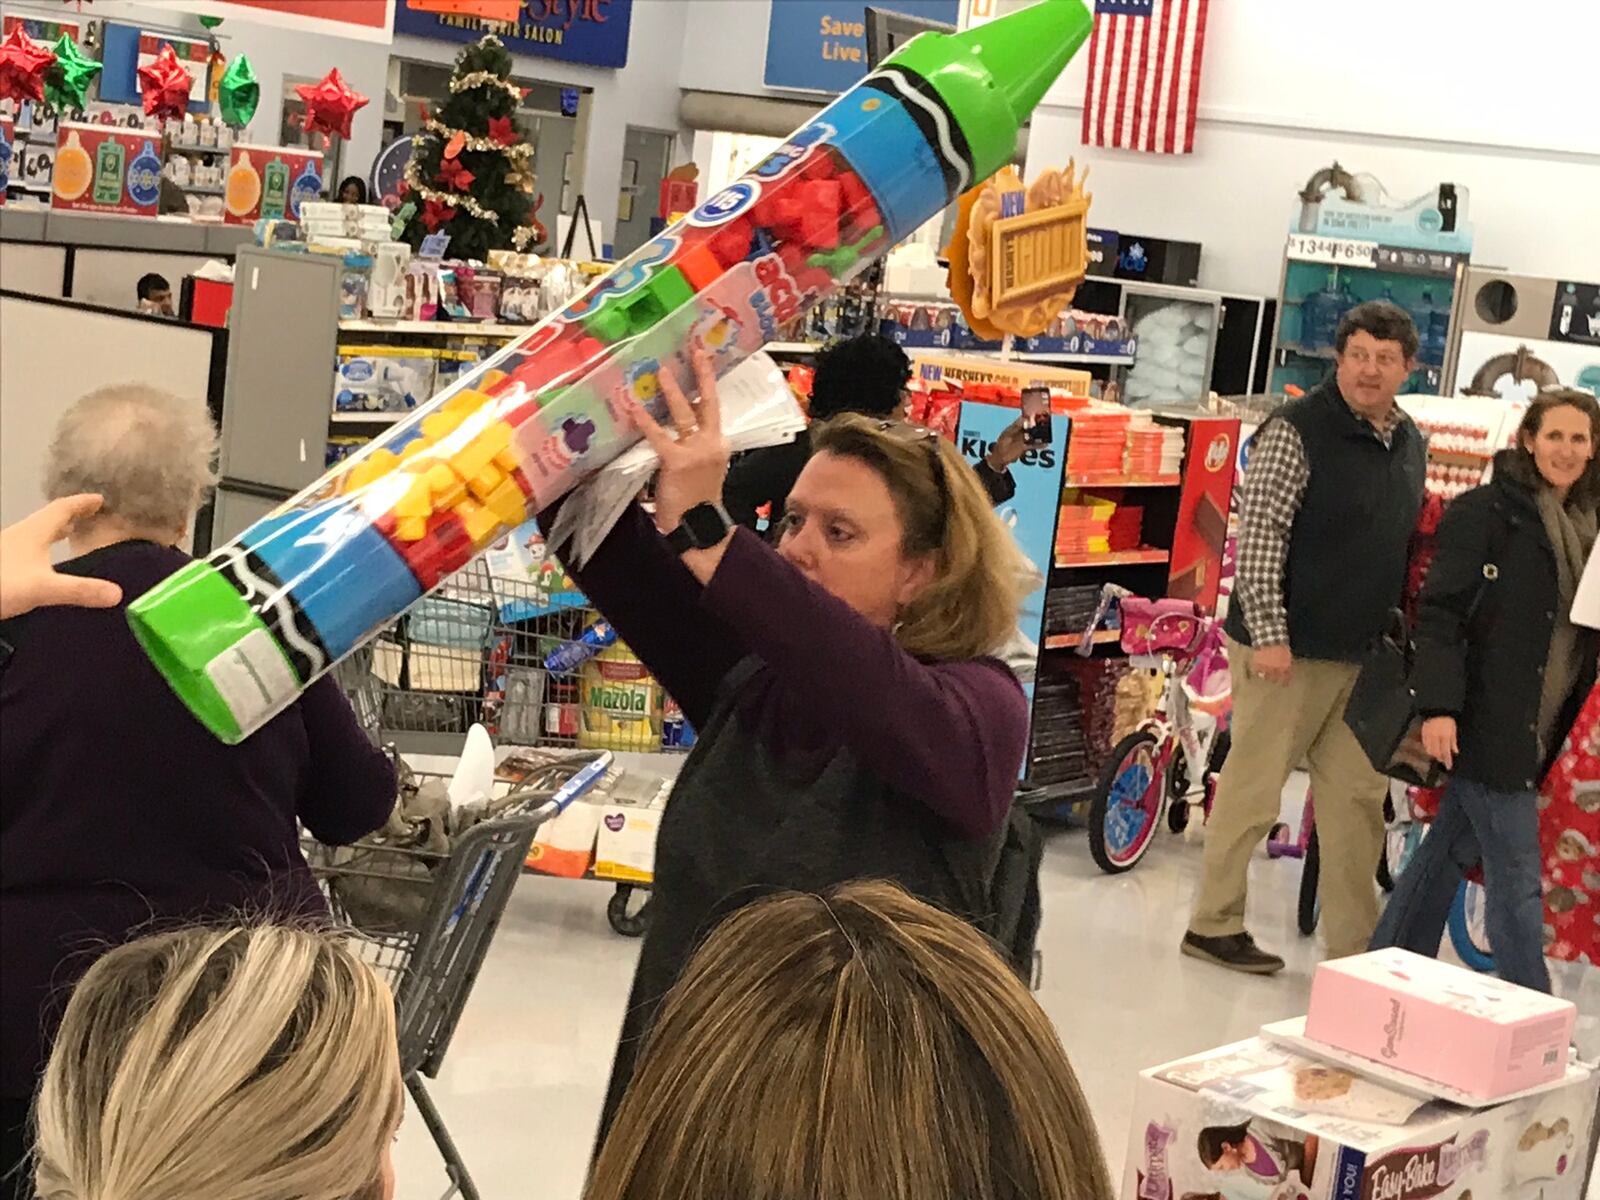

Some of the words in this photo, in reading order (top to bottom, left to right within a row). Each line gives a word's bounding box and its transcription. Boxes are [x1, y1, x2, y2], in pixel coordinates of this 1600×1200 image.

[524, 24, 563, 45] SALON
[820, 15, 865, 38] Save
[822, 41, 862, 63] Live
[919, 363, 943, 381] NEW
[944, 367, 993, 384] HERSHEY'S
[591, 686, 647, 712] Mazola
